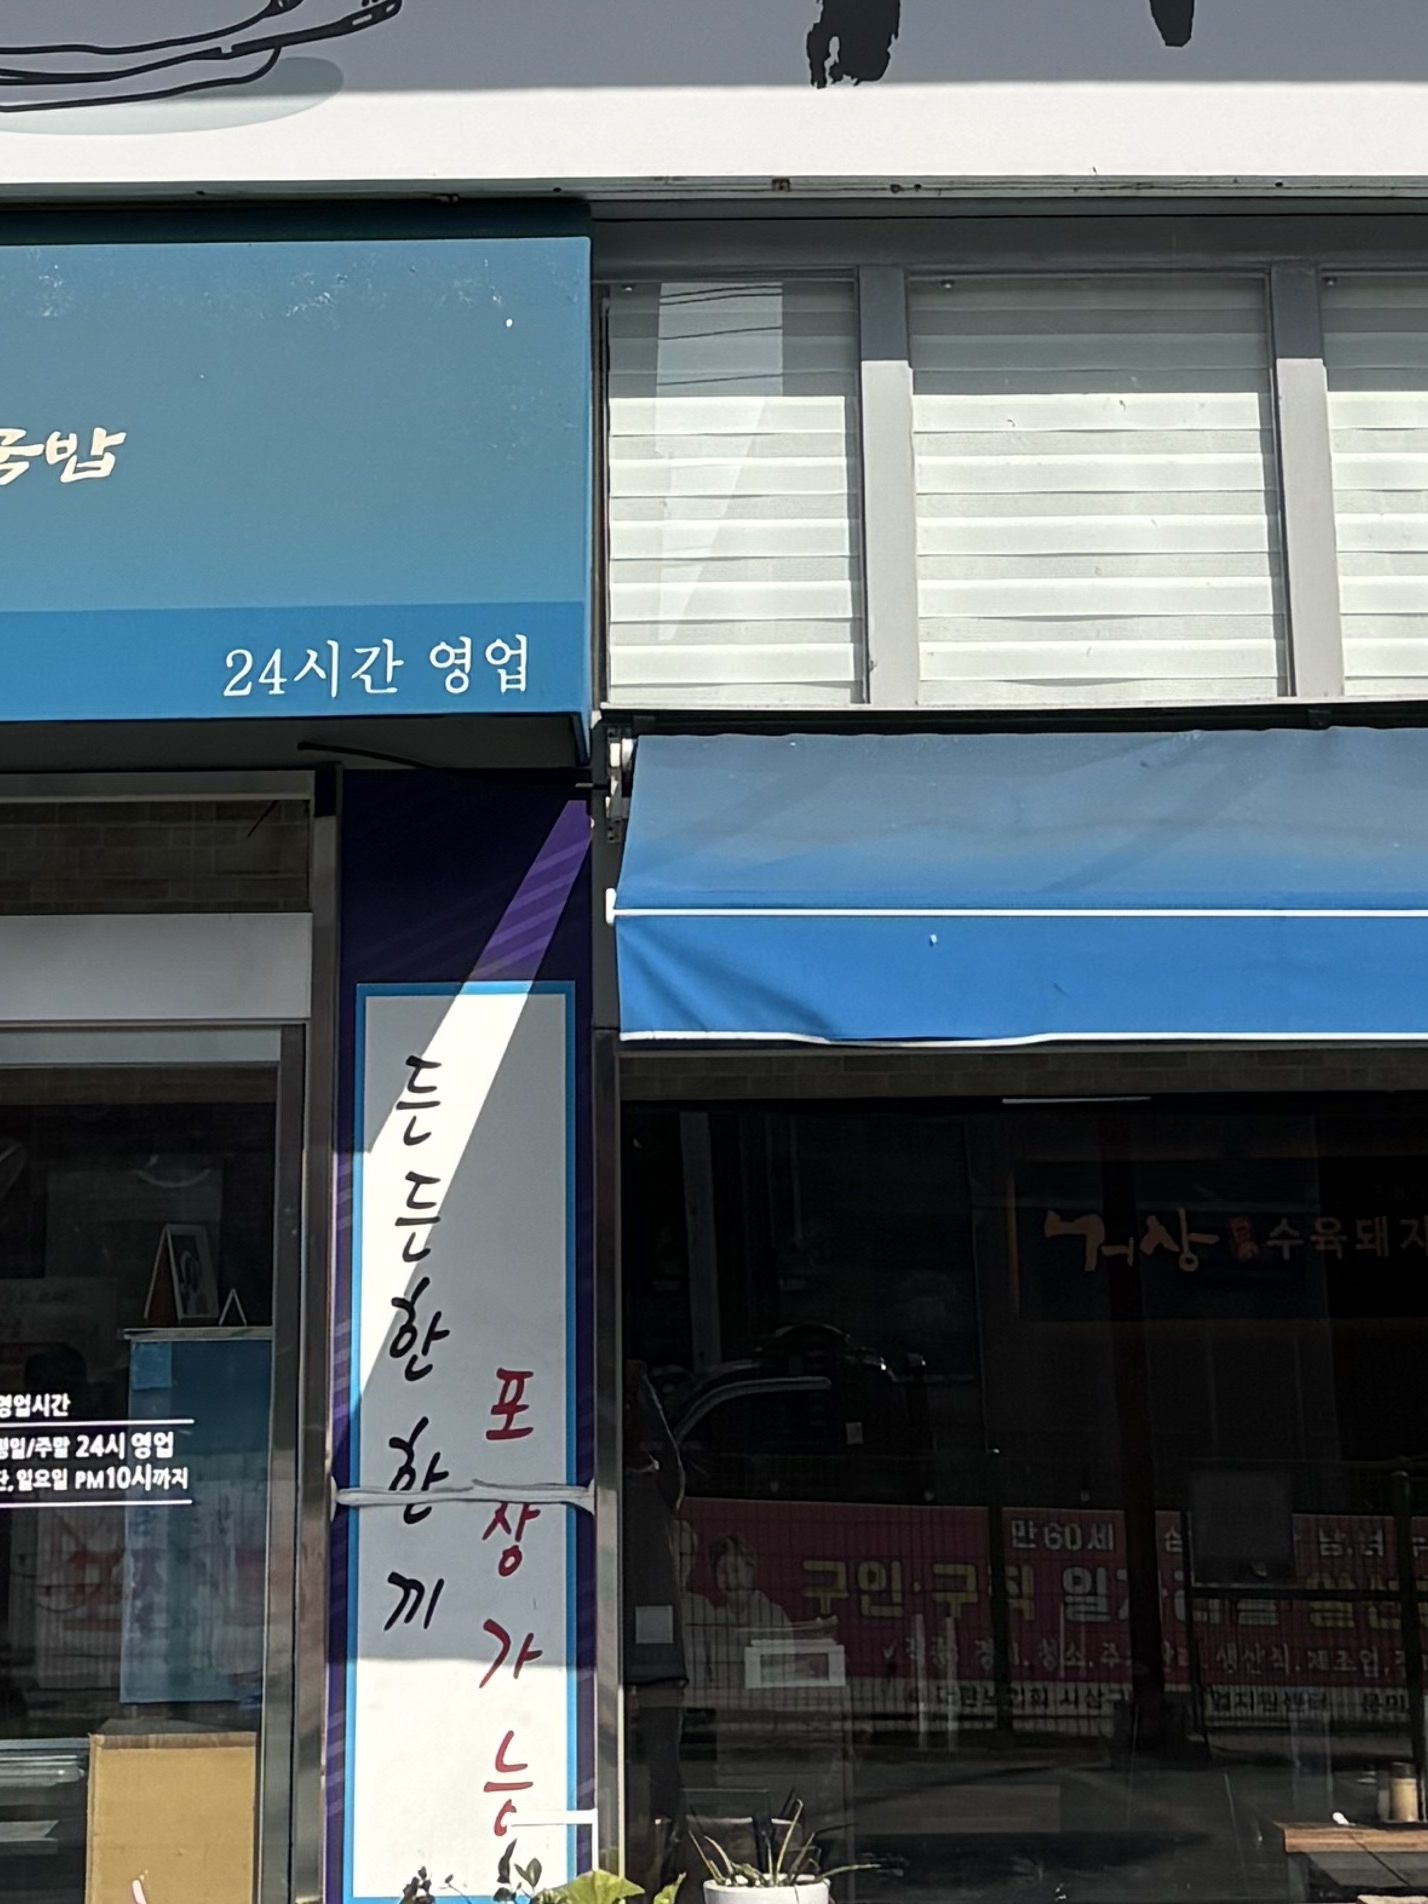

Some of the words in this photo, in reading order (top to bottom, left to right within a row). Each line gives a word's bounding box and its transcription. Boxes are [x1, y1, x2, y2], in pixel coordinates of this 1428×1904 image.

[223, 638, 405, 698] 24시간
[429, 634, 527, 694] 영업
[389, 1055, 450, 1382] 든든한
[75, 1431, 125, 1460] 24시
[130, 1431, 175, 1460] 영업
[75, 1463, 189, 1491] PM10시까지
